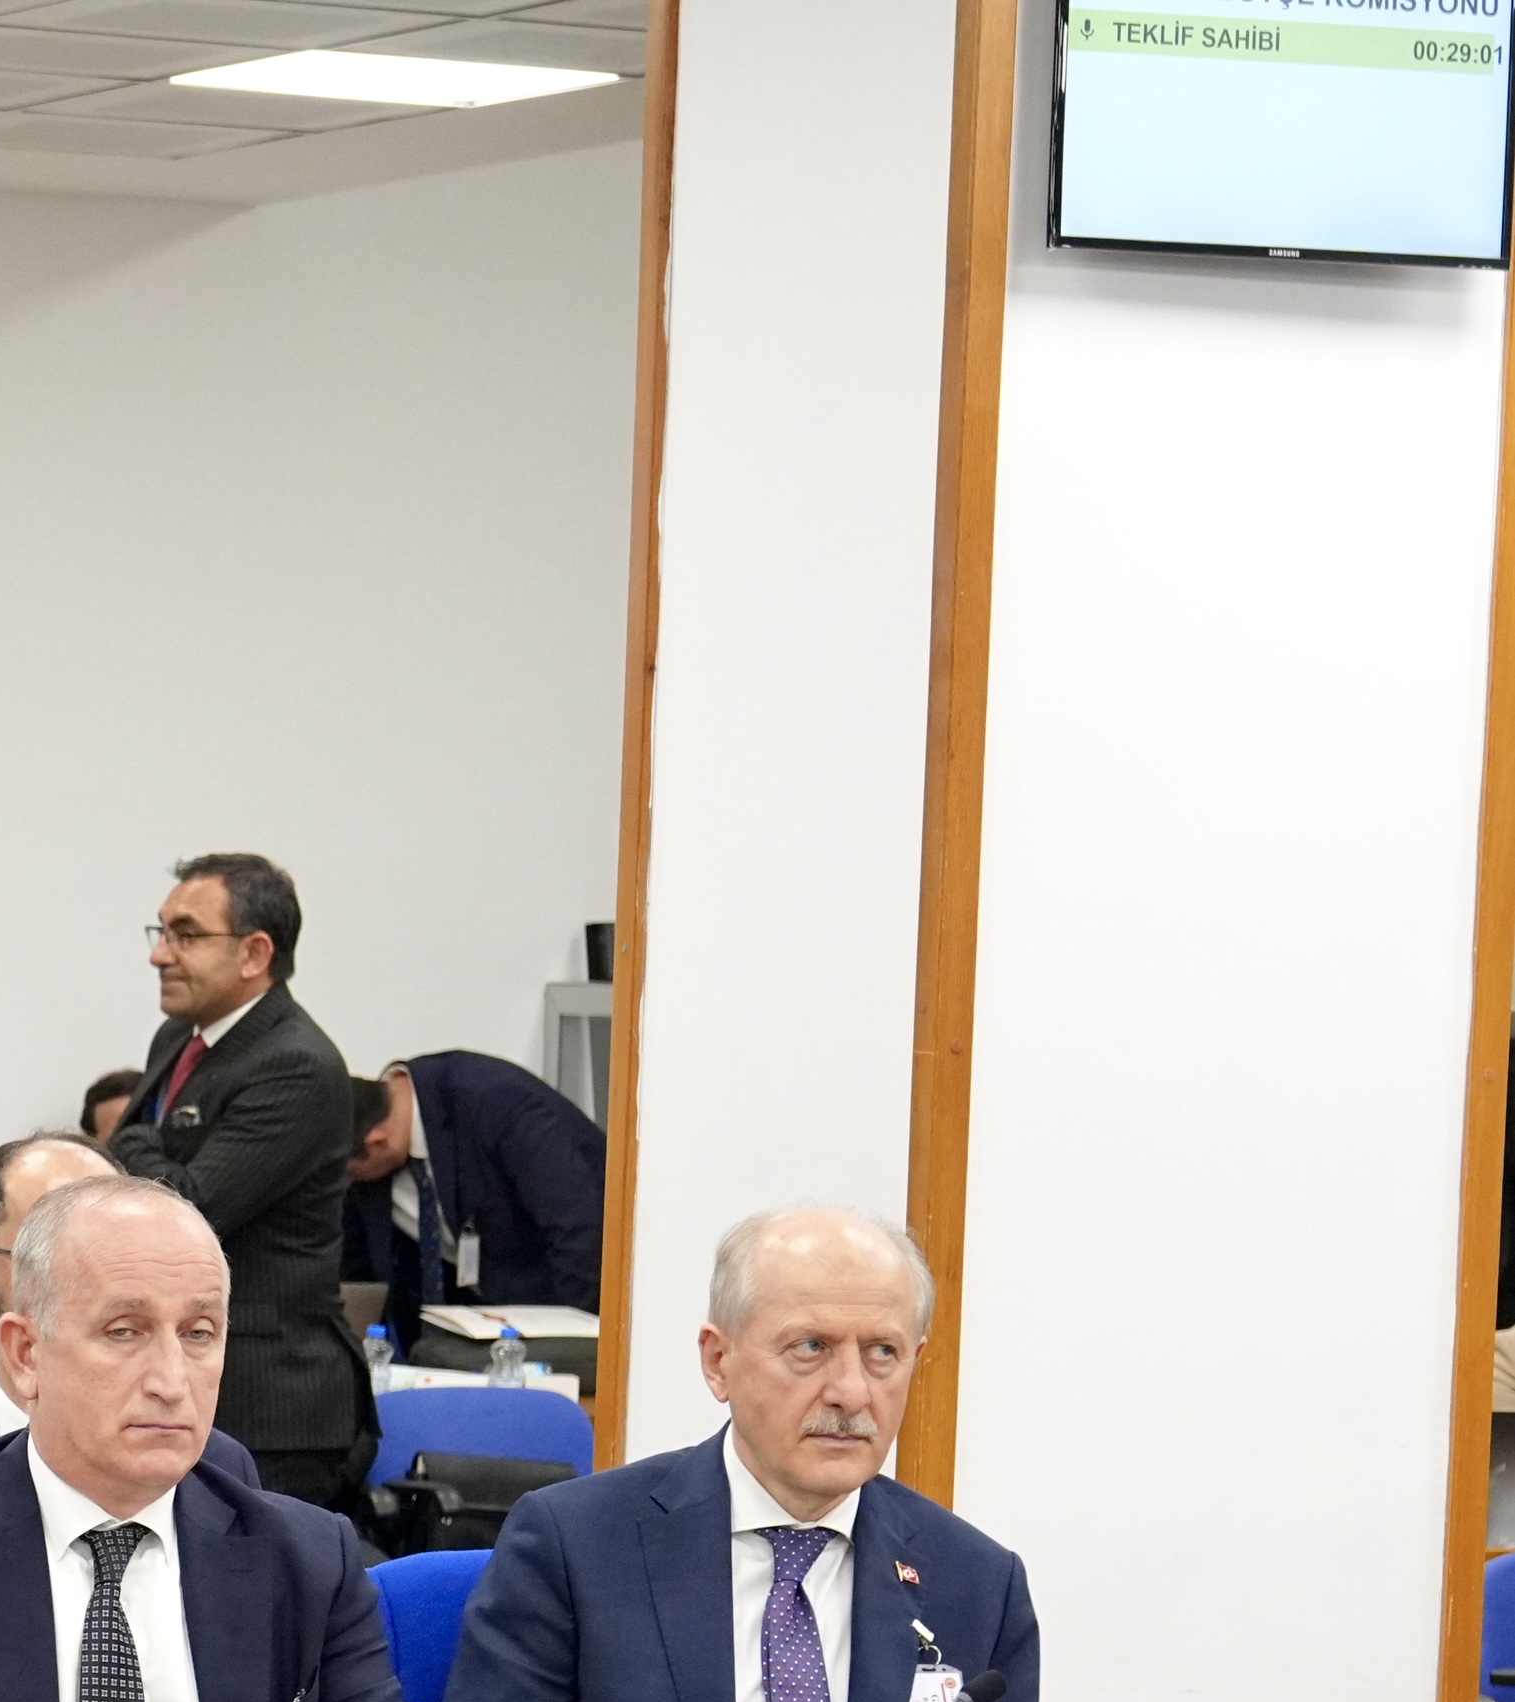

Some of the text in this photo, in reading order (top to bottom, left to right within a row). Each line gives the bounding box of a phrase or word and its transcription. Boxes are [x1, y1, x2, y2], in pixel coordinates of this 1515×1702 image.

[1113, 20, 1280, 52] TEKLİF SAHİBİ
[1413, 40, 1502, 65] 00:29:01
